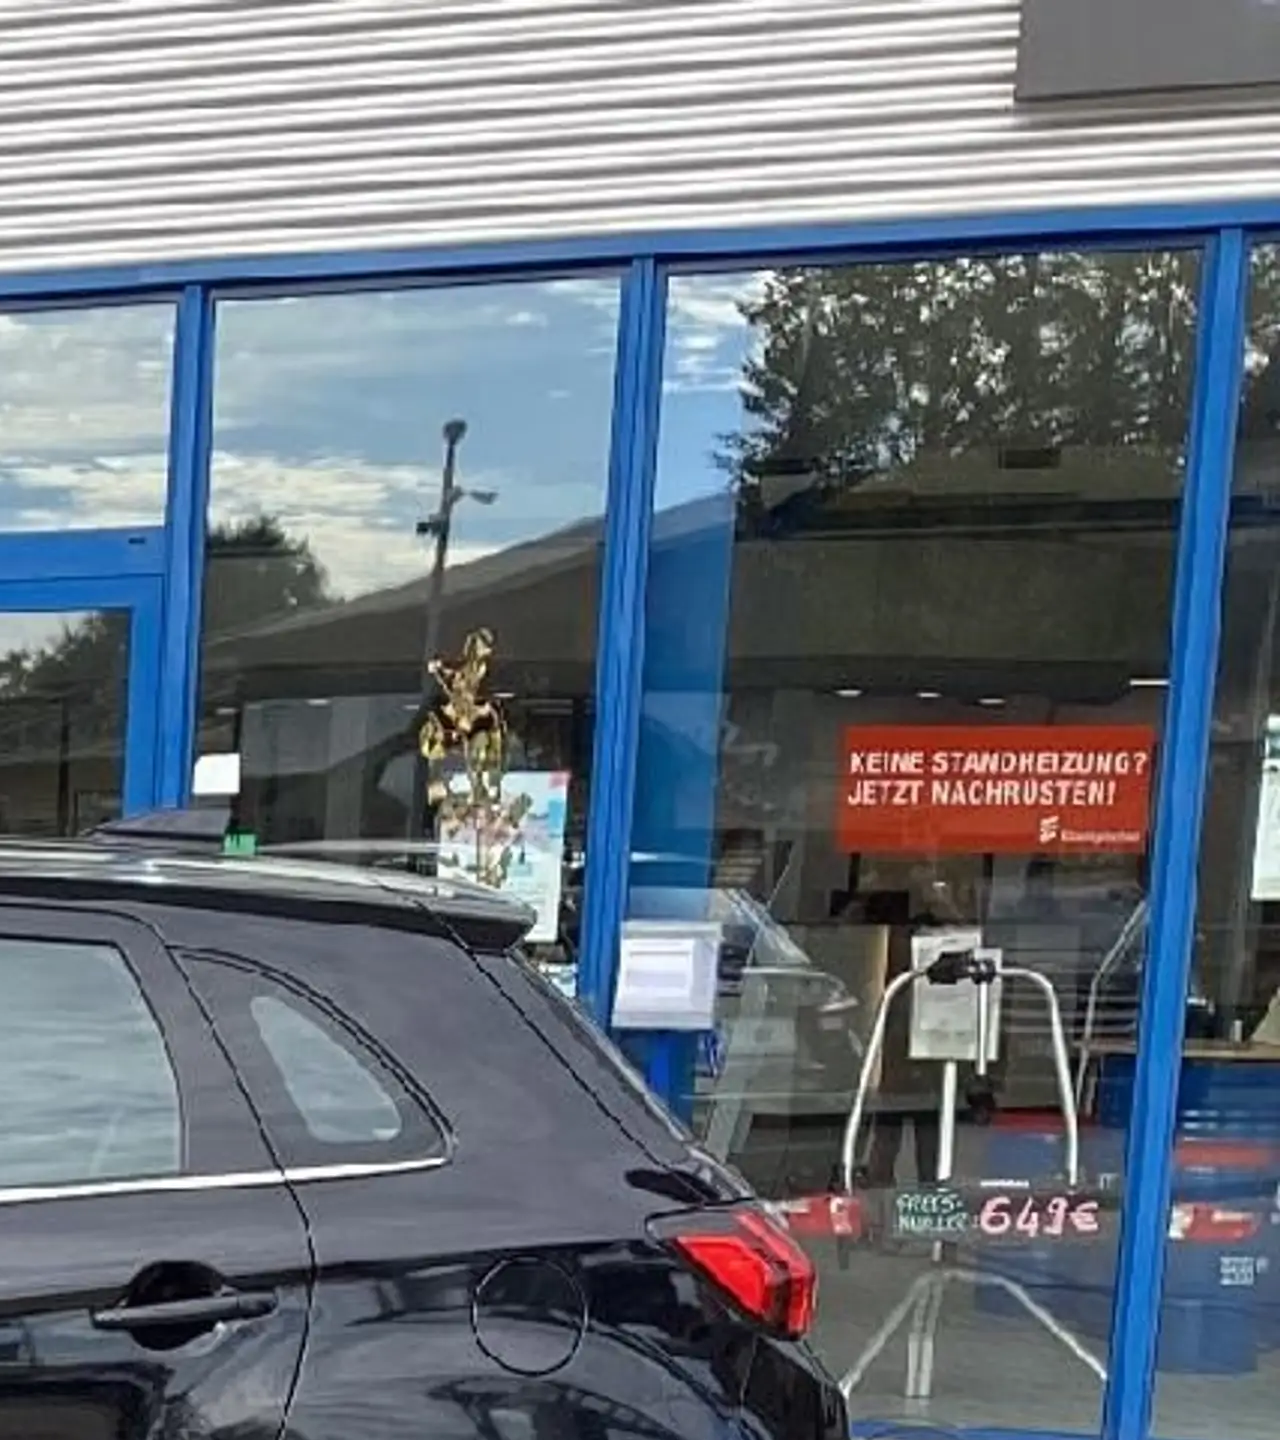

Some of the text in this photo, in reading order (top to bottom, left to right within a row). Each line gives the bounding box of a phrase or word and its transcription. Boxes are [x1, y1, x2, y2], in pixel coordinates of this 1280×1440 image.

[850, 751, 1147, 774] KEINE STANDHEIZUNG?
[847, 779, 1116, 806] JETZT NACHRÜSTEN!
[980, 1196, 1099, 1238] 649€
